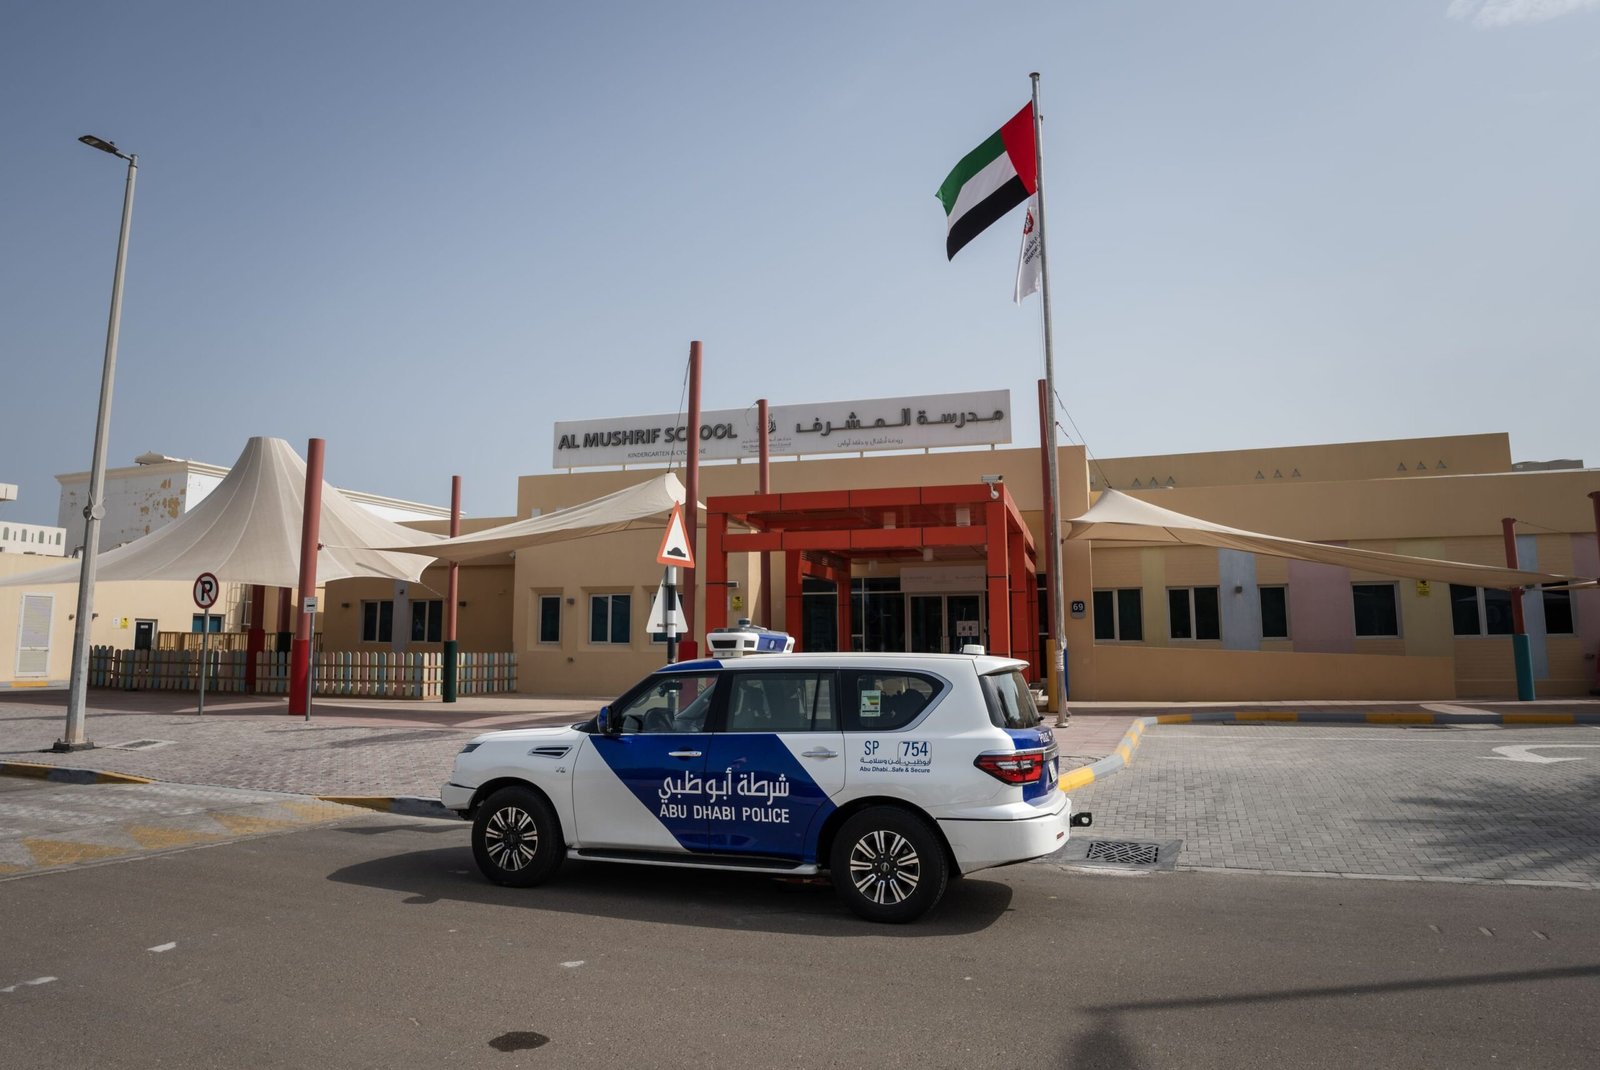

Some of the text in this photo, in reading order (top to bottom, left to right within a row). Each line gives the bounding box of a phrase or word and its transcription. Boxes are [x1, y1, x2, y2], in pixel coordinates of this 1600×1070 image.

[796, 407, 1004, 436] مدرسة المشرف
[558, 423, 738, 450] AL MUSHRIF SCOOL
[628, 450, 670, 459] KINDERGARTEN
[1073, 603, 1084, 611] 69
[864, 740, 929, 757] SP 754
[737, 772, 790, 806] شرطة
[659, 804, 790, 823] ABU DHABI POLICE
